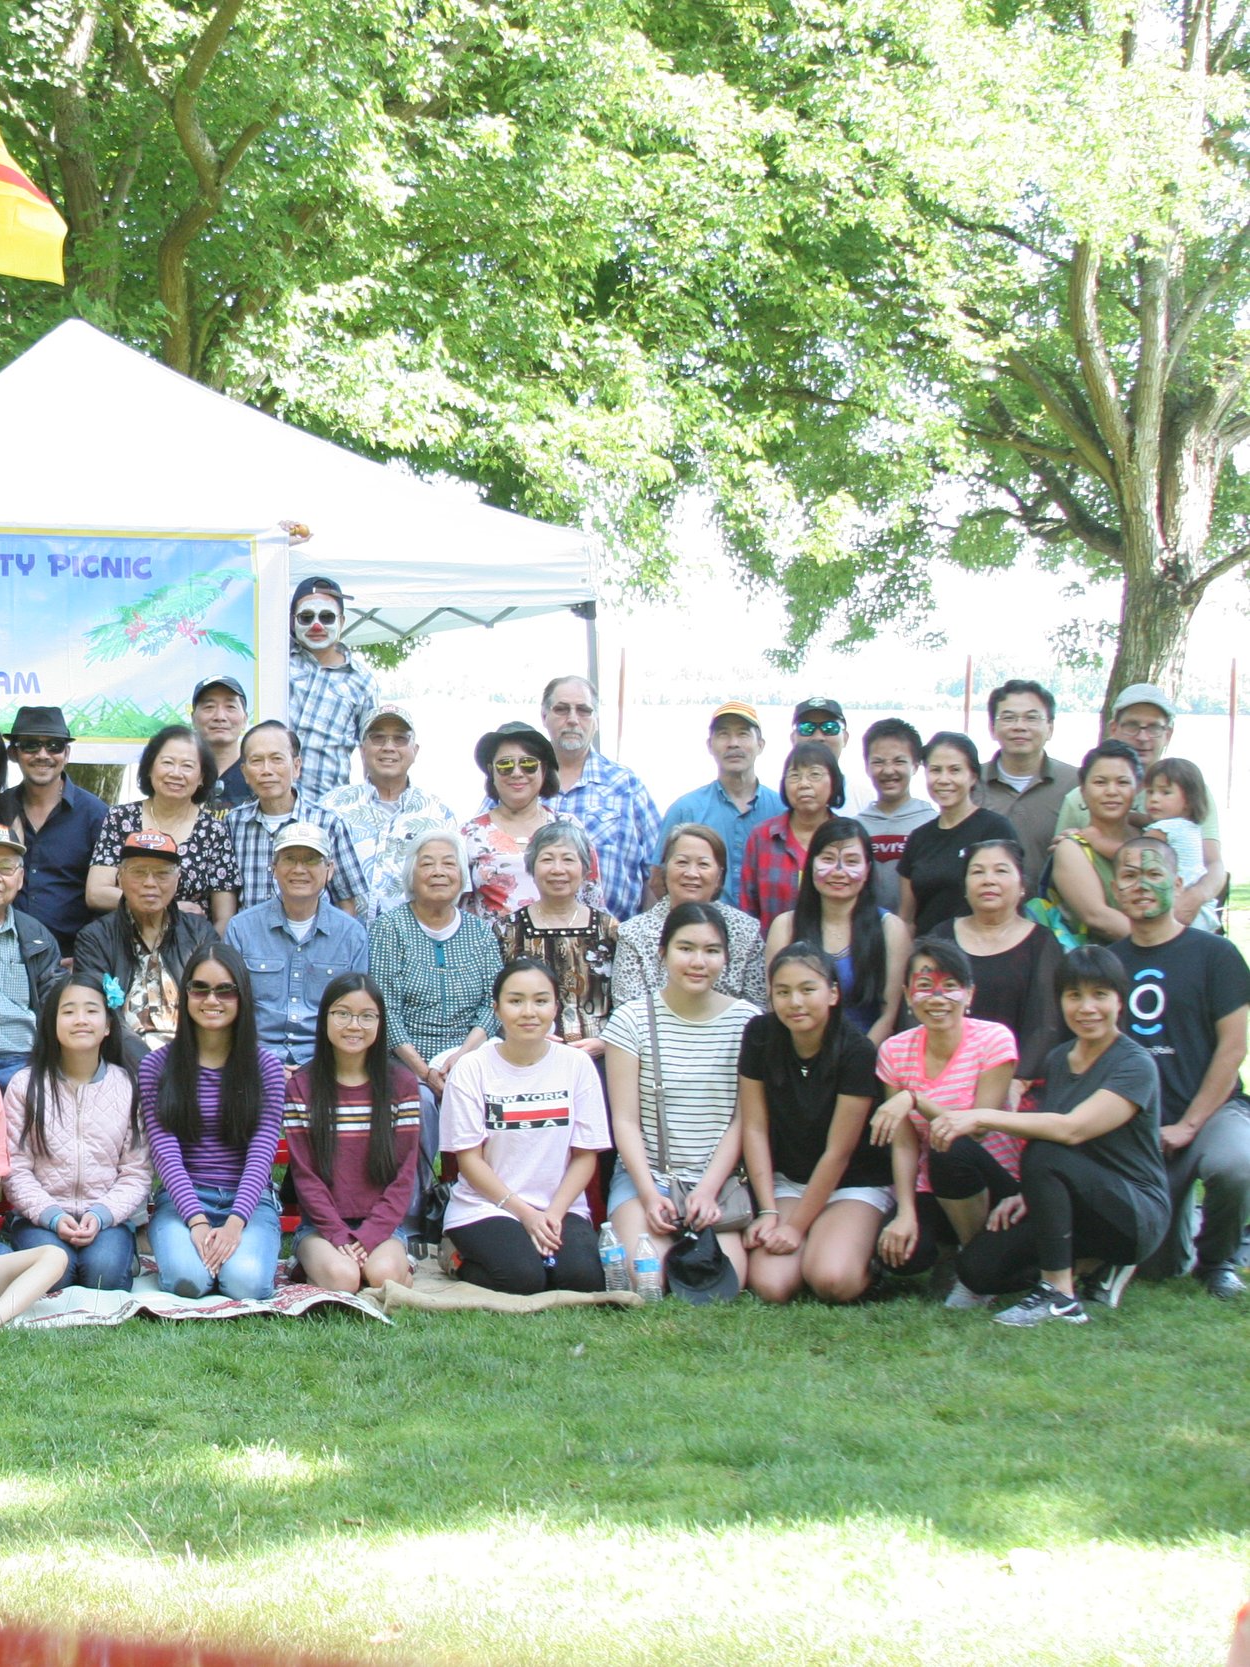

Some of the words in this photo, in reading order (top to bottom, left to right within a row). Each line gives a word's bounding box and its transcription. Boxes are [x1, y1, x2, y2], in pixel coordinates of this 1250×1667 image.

[48, 554, 153, 580] PICNIC
[135, 834, 166, 844] TEXAS
[484, 1094, 518, 1103] NEW
[521, 1091, 566, 1102] YORK
